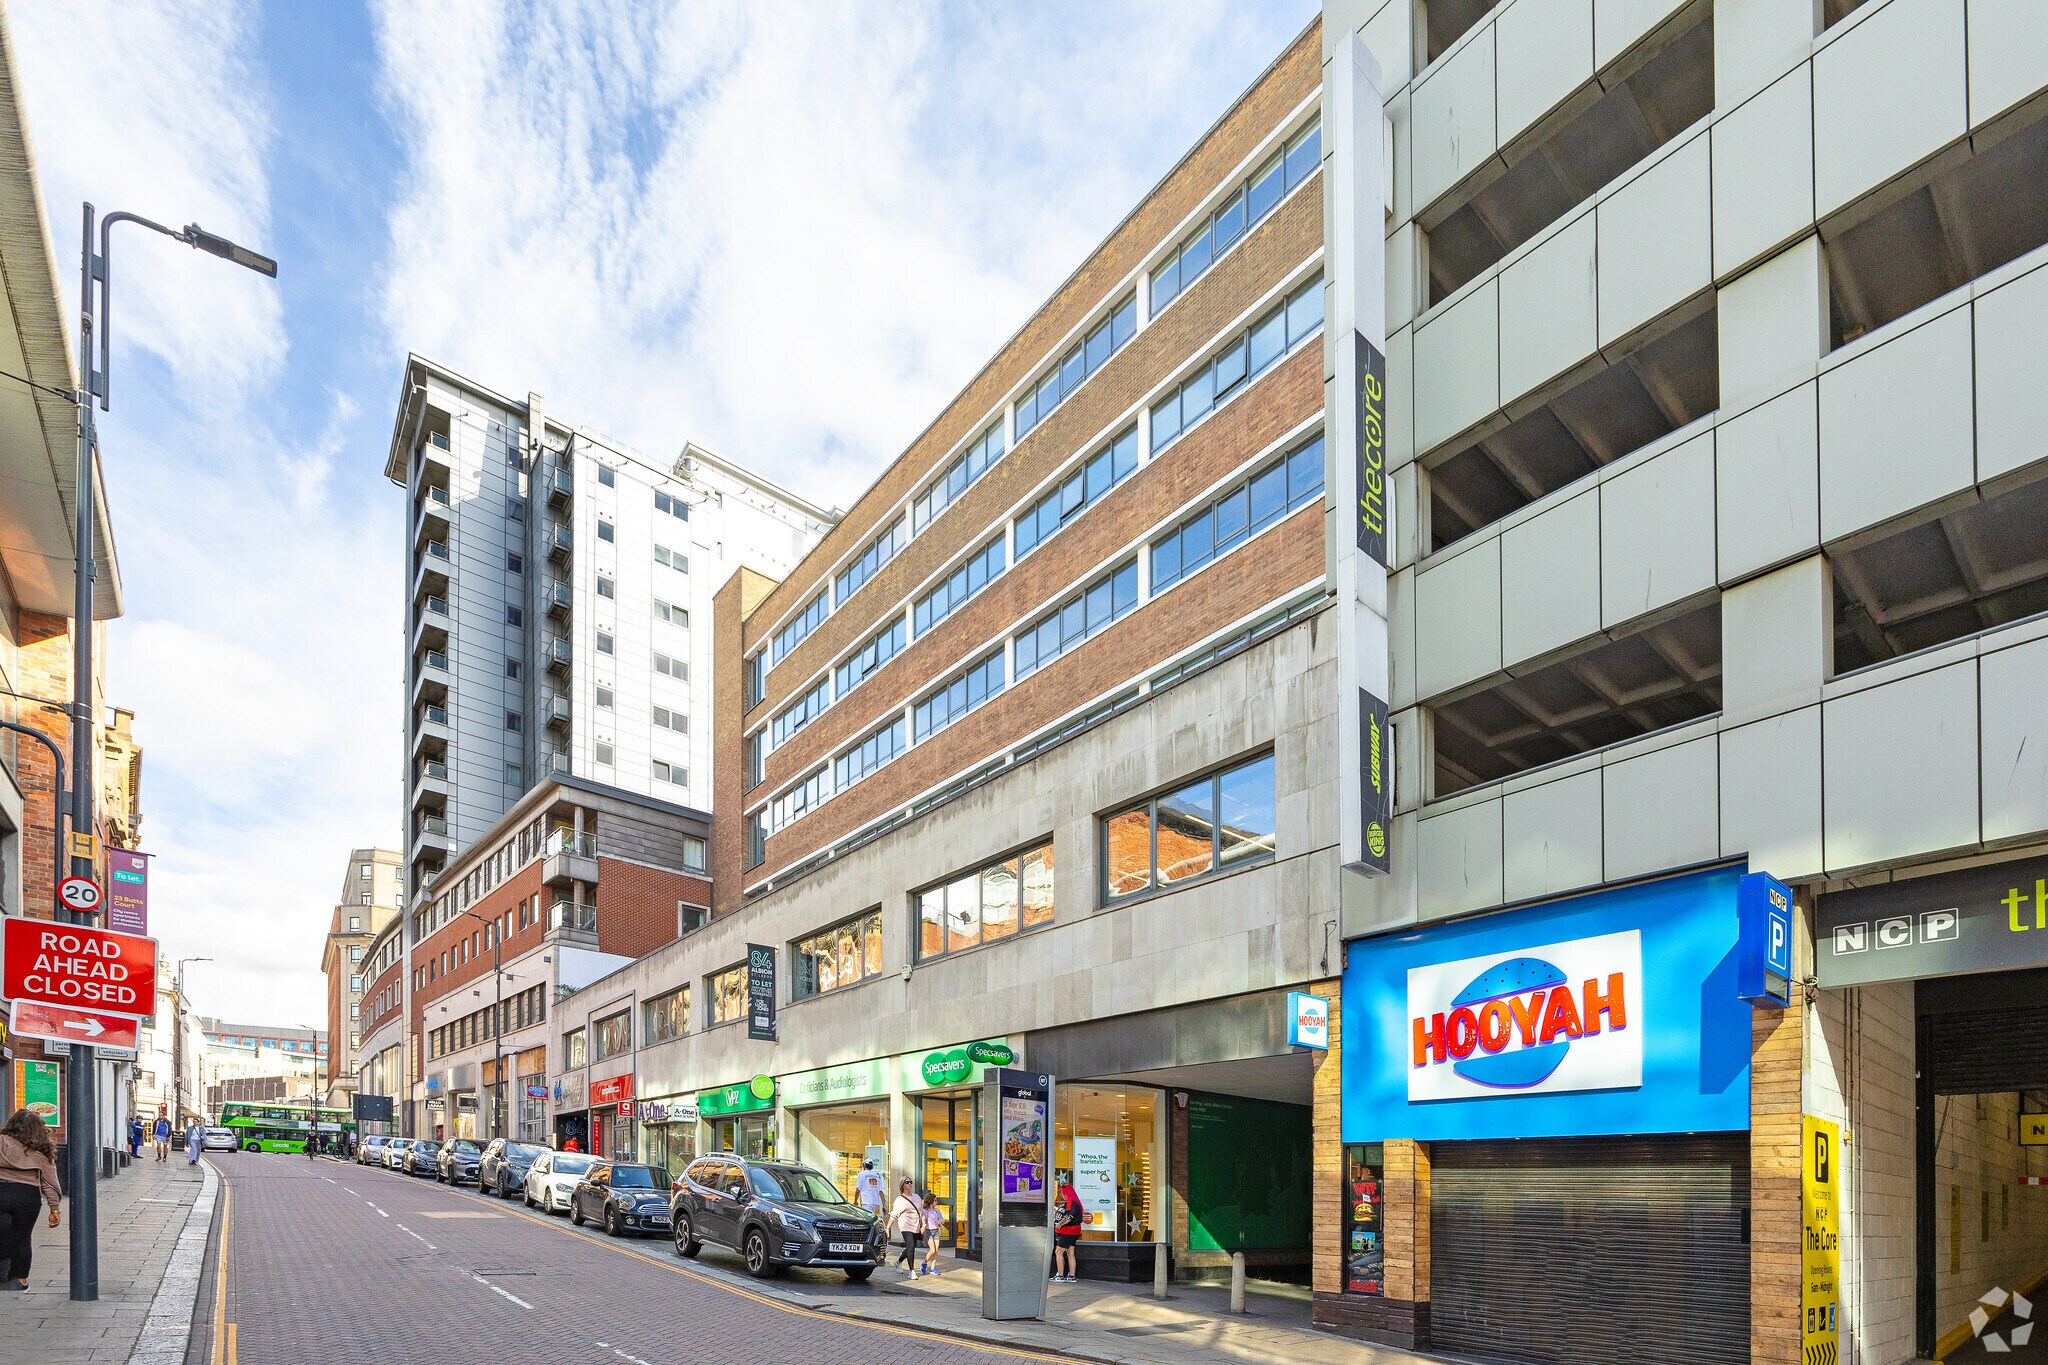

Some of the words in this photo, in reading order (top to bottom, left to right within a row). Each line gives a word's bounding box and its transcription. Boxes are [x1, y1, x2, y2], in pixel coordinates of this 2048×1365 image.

[1360, 372, 1382, 535] thecore
[1369, 712, 1381, 794] SUBWAY
[1369, 837, 1385, 847] KING
[116, 872, 126, 880] To
[128, 874, 142, 883] Let.
[65, 885, 97, 903] 20
[124, 896, 144, 905] Butts
[1769, 888, 1787, 912] NCP
[114, 900, 136, 909] Court
[1772, 920, 1784, 960] P
[1835, 911, 1957, 954] NCP
[41, 931, 121, 959] ROAD
[32, 954, 128, 982] AHEAD
[751, 950, 772, 969] 84
[751, 967, 772, 975] ALBION
[24, 974, 136, 1004] CLOSED
[1298, 1016, 1326, 1027] HOOYAH
[1413, 971, 1627, 1068] HOOYAH
[975, 1046, 1011, 1060] Specsavers
[925, 1059, 965, 1076] Specsavers
[756, 1082, 772, 1092] VPZ
[800, 1080, 824, 1094] Opticians
[824, 1081, 829, 1090] &
[829, 1075, 866, 1090] Audiologists
[727, 1089, 739, 1105] VPZ
[566, 1120, 586, 1136] 84
[2032, 1125, 2045, 1135] N
[1818, 1136, 1827, 1178] P
[1353, 1182, 1376, 1196] WTF
[1816, 1208, 1828, 1220] NCP
[1806, 1226, 1820, 1250] The
[1821, 1226, 1837, 1250] Core
